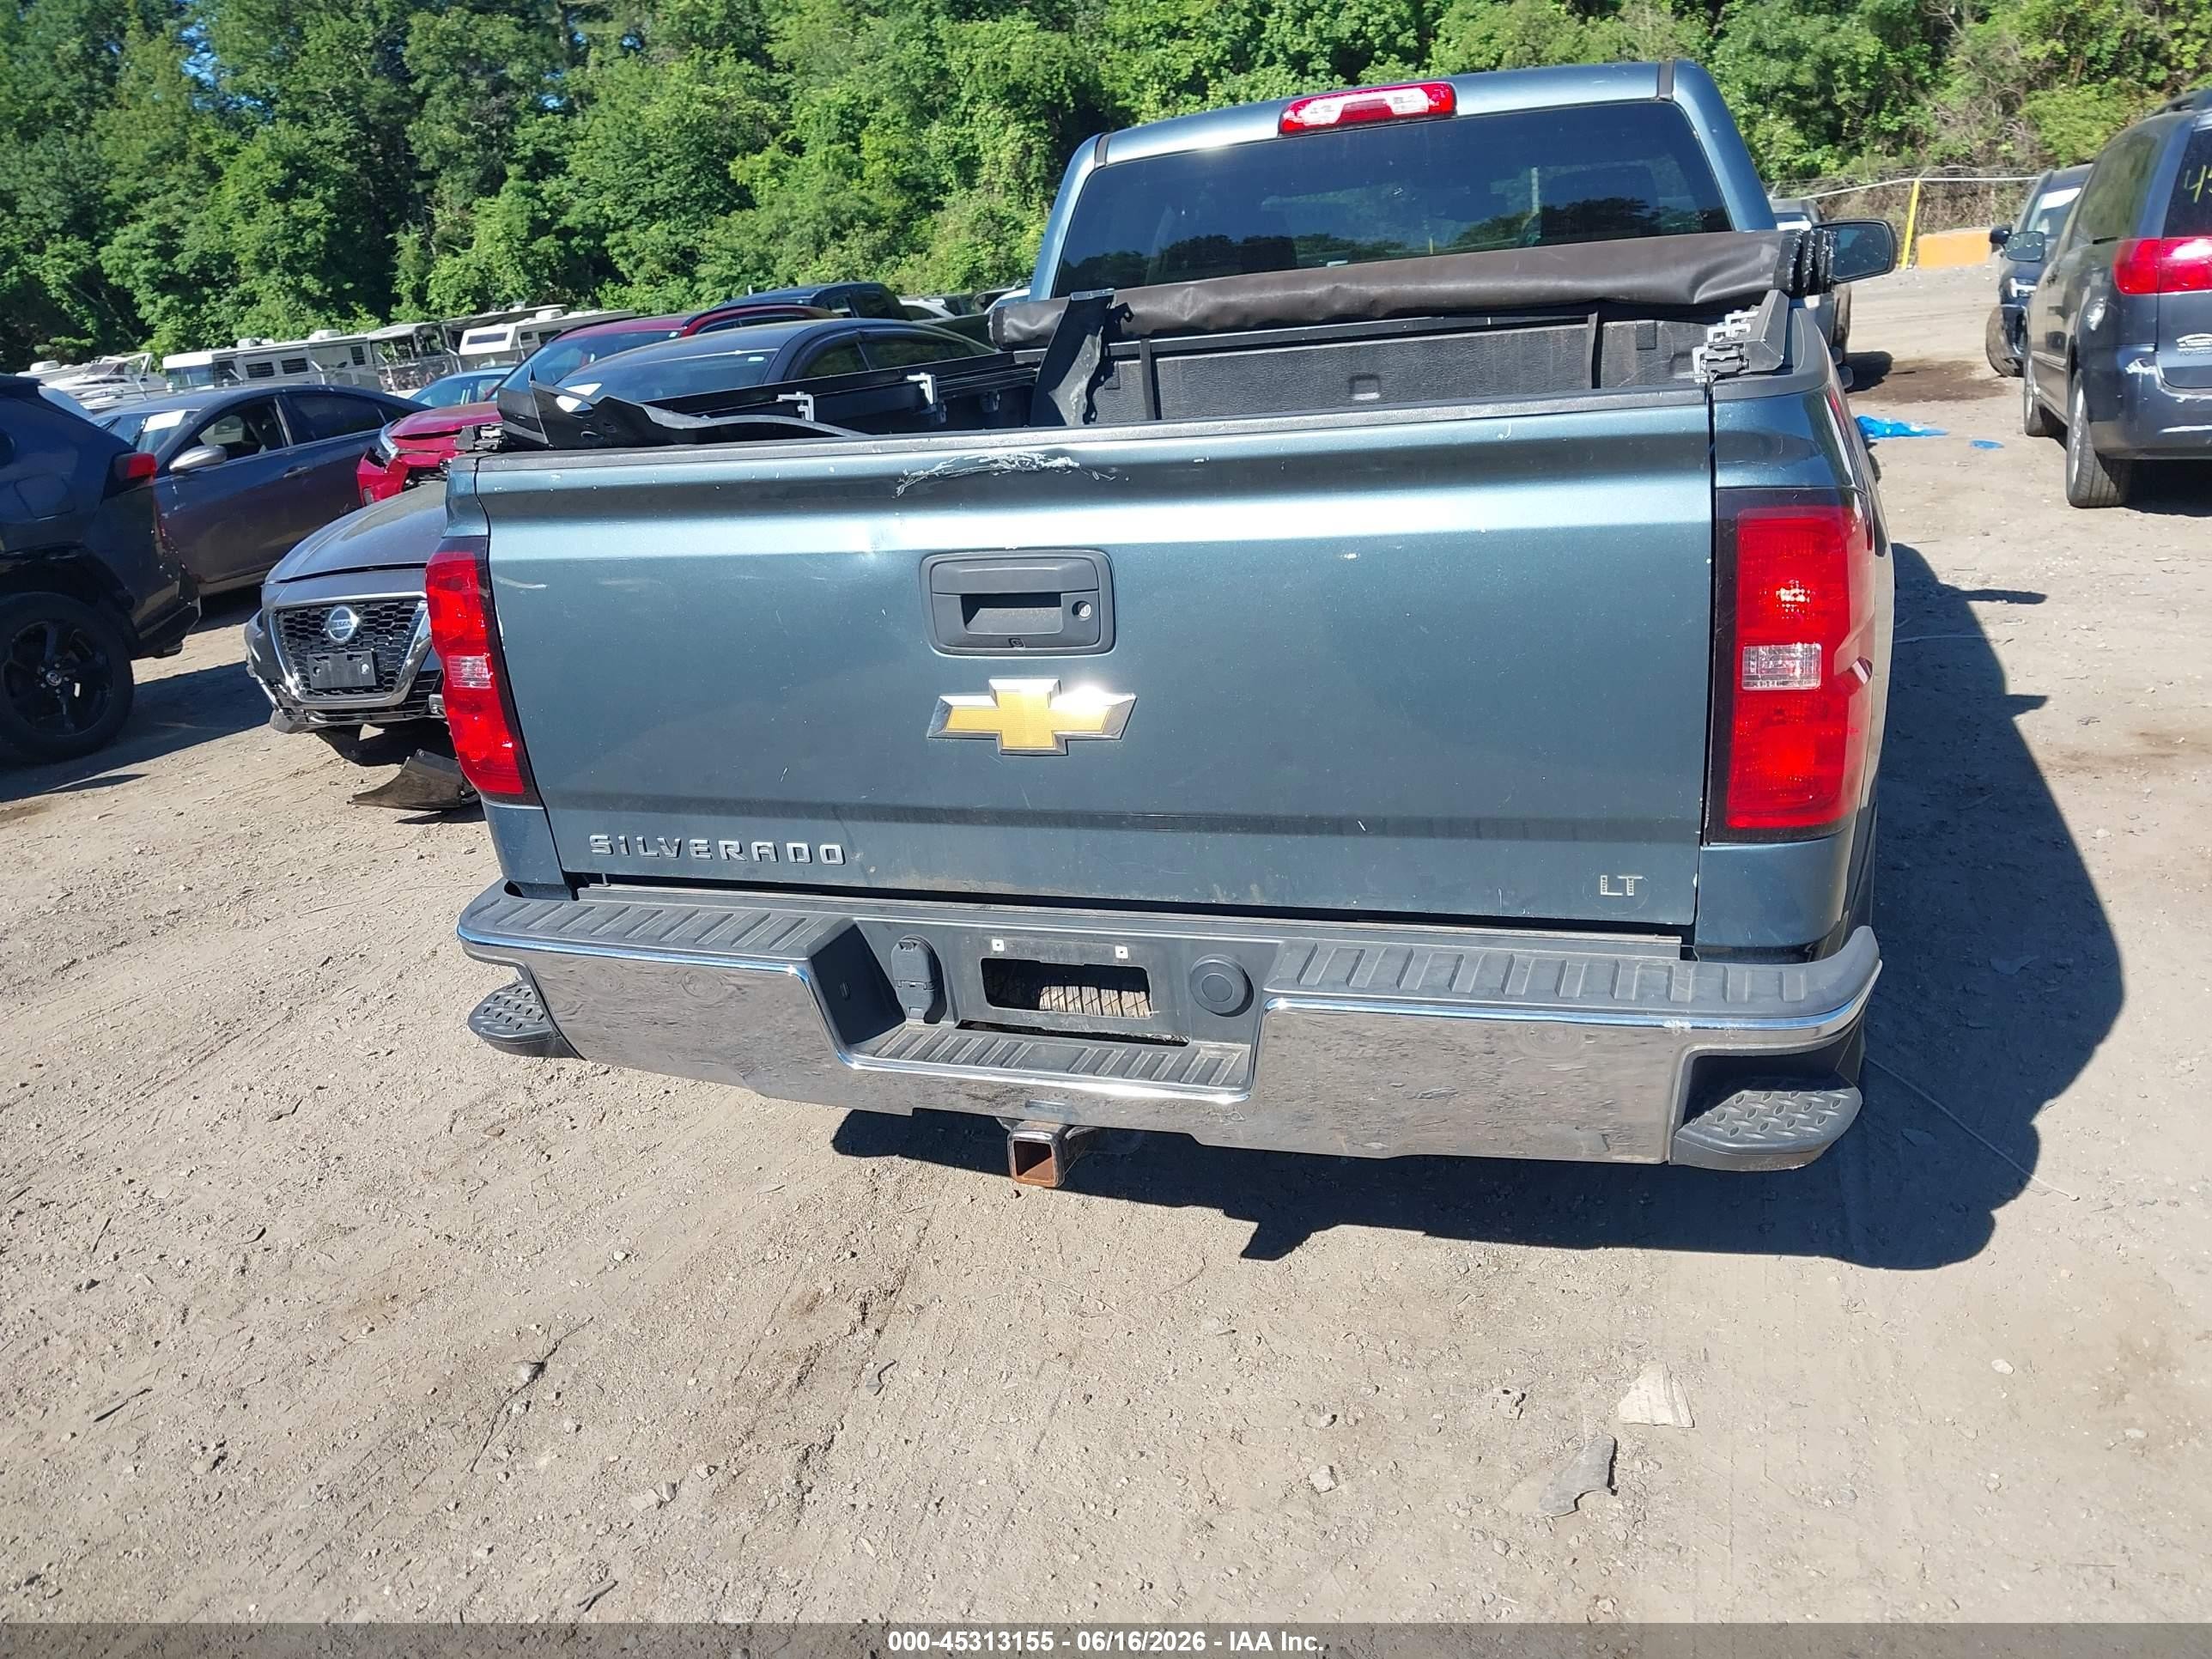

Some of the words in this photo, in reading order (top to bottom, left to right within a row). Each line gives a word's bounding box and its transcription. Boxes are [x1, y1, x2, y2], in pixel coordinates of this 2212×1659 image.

[2184, 164, 2212, 204] 4
[588, 834, 847, 866] SILVERADO
[1600, 874, 1644, 896] LT
